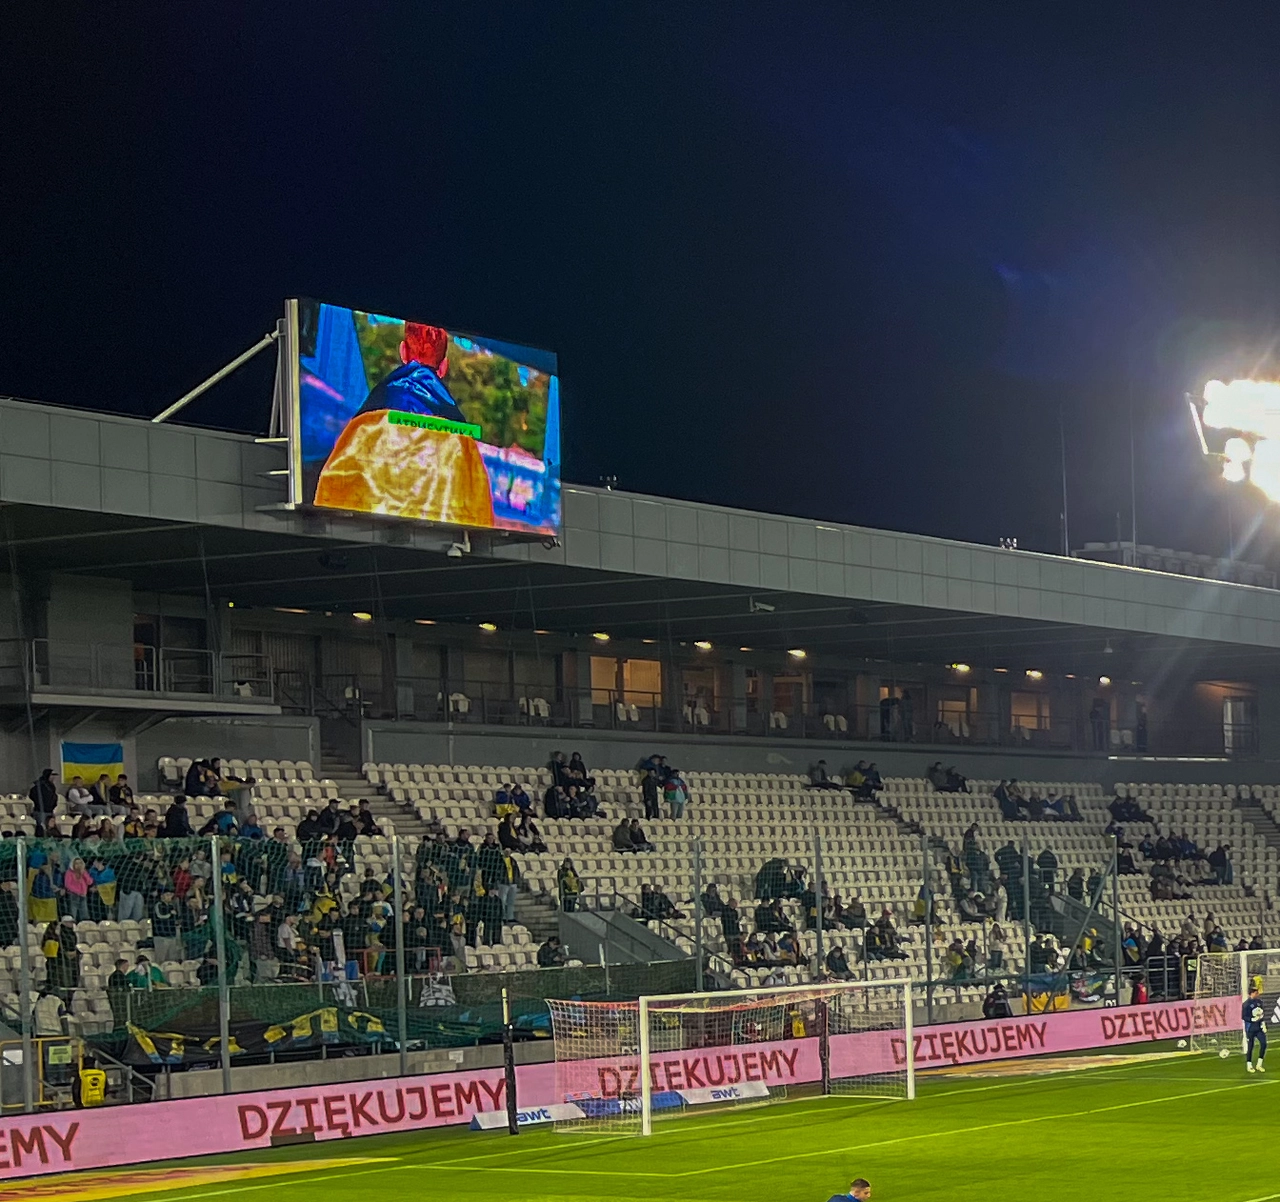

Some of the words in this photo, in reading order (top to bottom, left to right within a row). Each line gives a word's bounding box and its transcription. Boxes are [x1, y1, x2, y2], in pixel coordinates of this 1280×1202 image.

[1101, 1004, 1227, 1041] DZIĘKUJEMY
[890, 1022, 1048, 1064] DZIĘKUJEMY
[238, 1078, 507, 1140] DZIĘKUJEMY
[711, 1086, 741, 1099] awt
